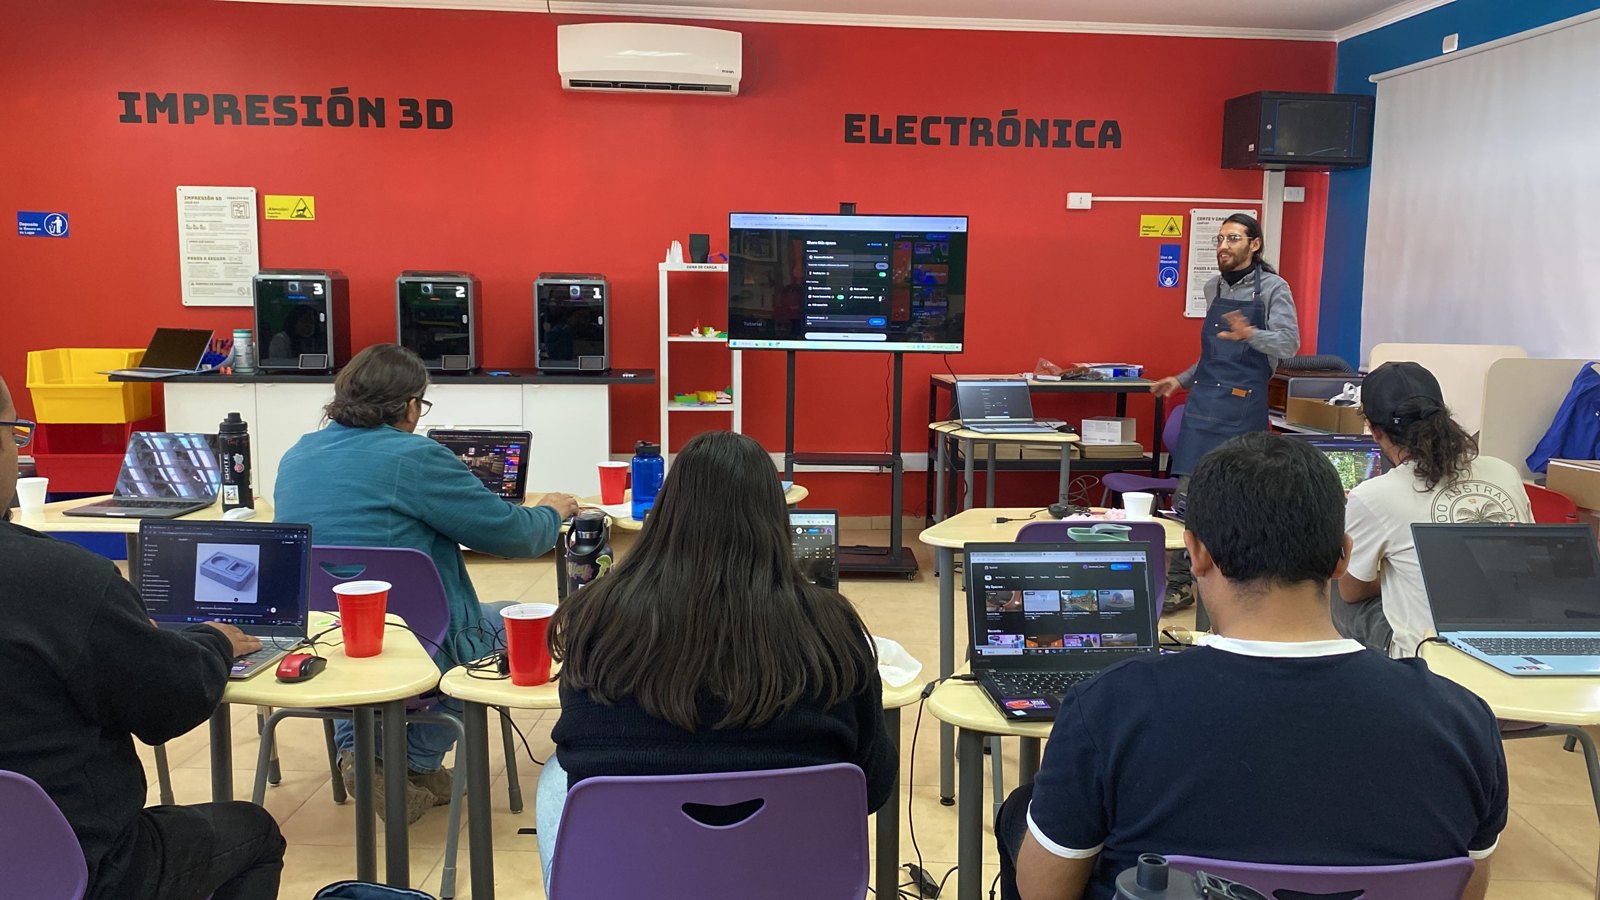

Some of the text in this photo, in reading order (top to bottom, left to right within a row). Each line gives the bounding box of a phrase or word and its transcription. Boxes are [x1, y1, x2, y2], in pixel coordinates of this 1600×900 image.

[118, 87, 453, 129] IMPRESIÓN 3D
[845, 109, 1122, 149] ELECTRÓNICA
[313, 283, 323, 294] 3
[456, 286, 465, 298] 2
[593, 288, 601, 298] 1
[1445, 484, 1516, 521] AUSTRALIA
